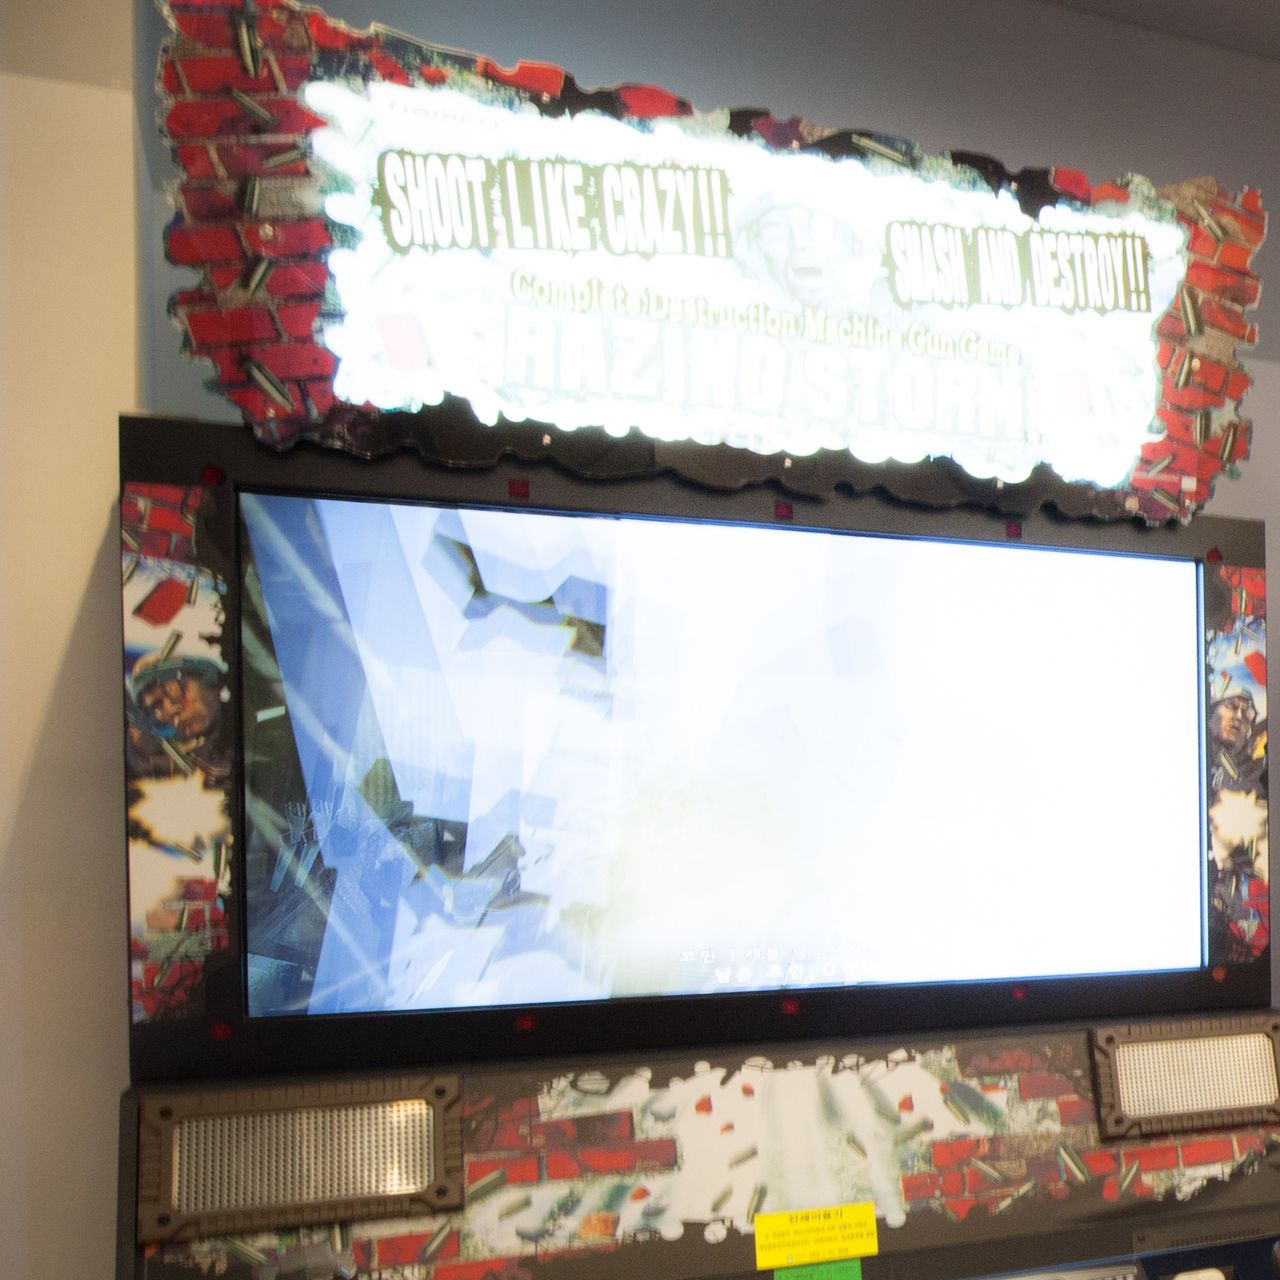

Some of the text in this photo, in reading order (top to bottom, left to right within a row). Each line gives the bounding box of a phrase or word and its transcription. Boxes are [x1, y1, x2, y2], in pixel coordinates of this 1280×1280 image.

[383, 151, 727, 258] SHOOT LIKE CRAZY!!
[889, 221, 1149, 313] SMASH AND DESTROY!!
